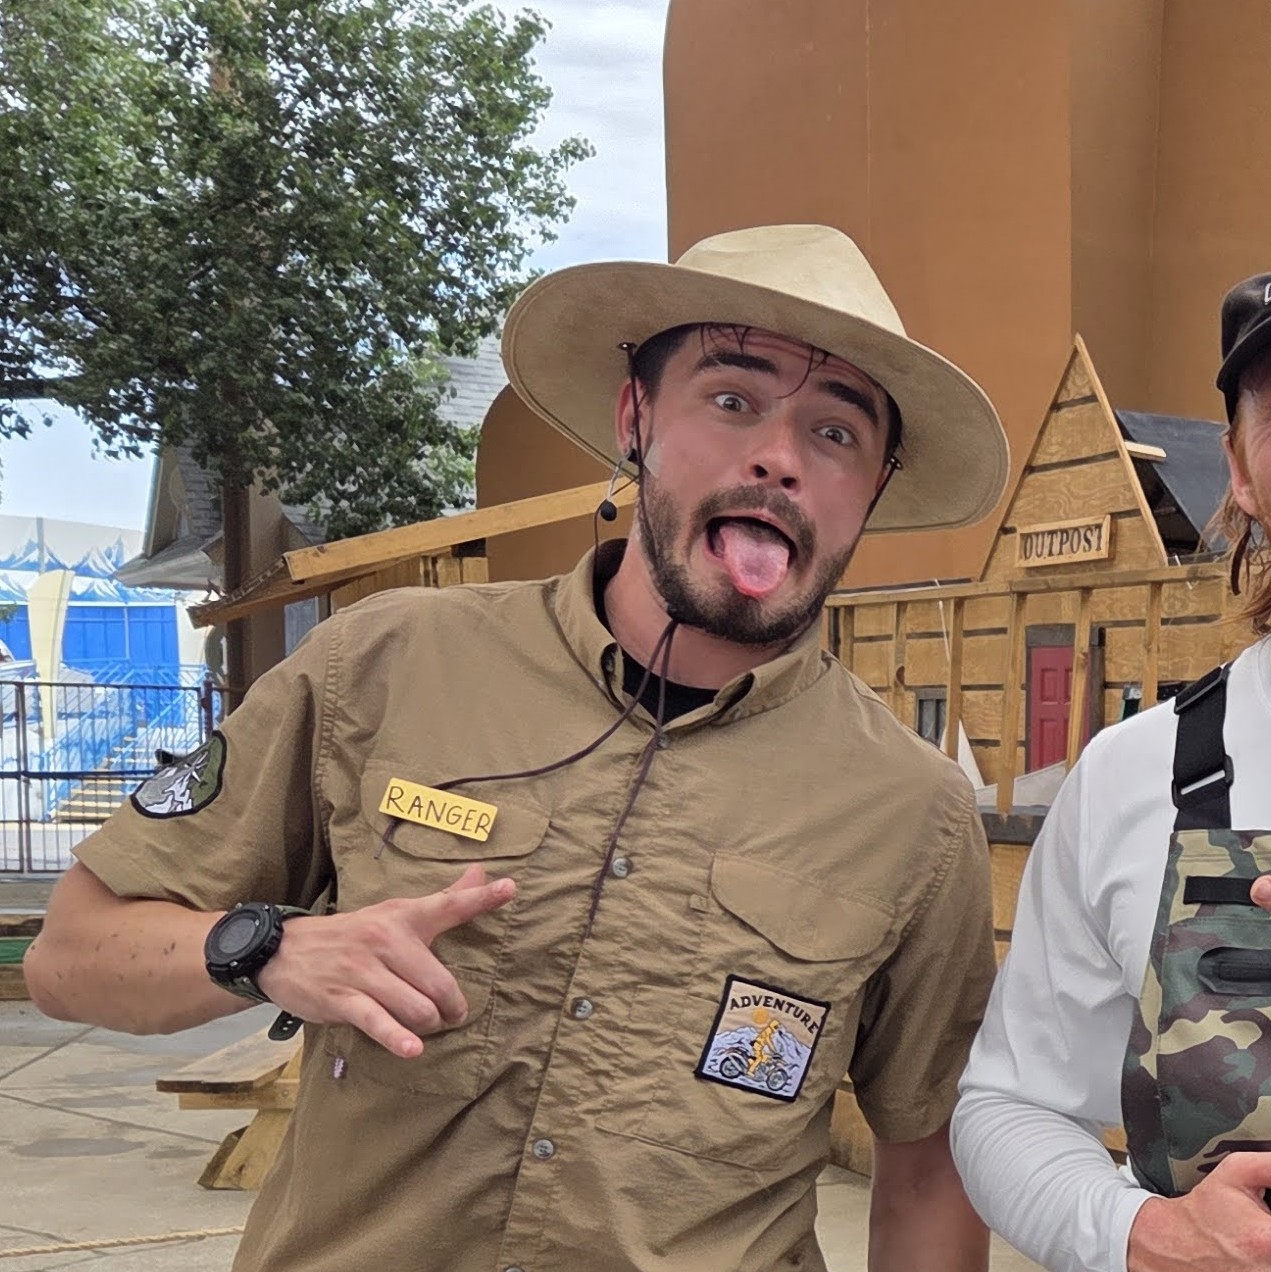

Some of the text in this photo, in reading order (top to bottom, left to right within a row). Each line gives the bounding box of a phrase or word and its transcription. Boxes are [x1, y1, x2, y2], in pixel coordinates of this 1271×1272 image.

[1024, 523, 1103, 560] OUTPOST
[386, 786, 491, 834] RANGER
[730, 995, 819, 1034] ADVENTURE
